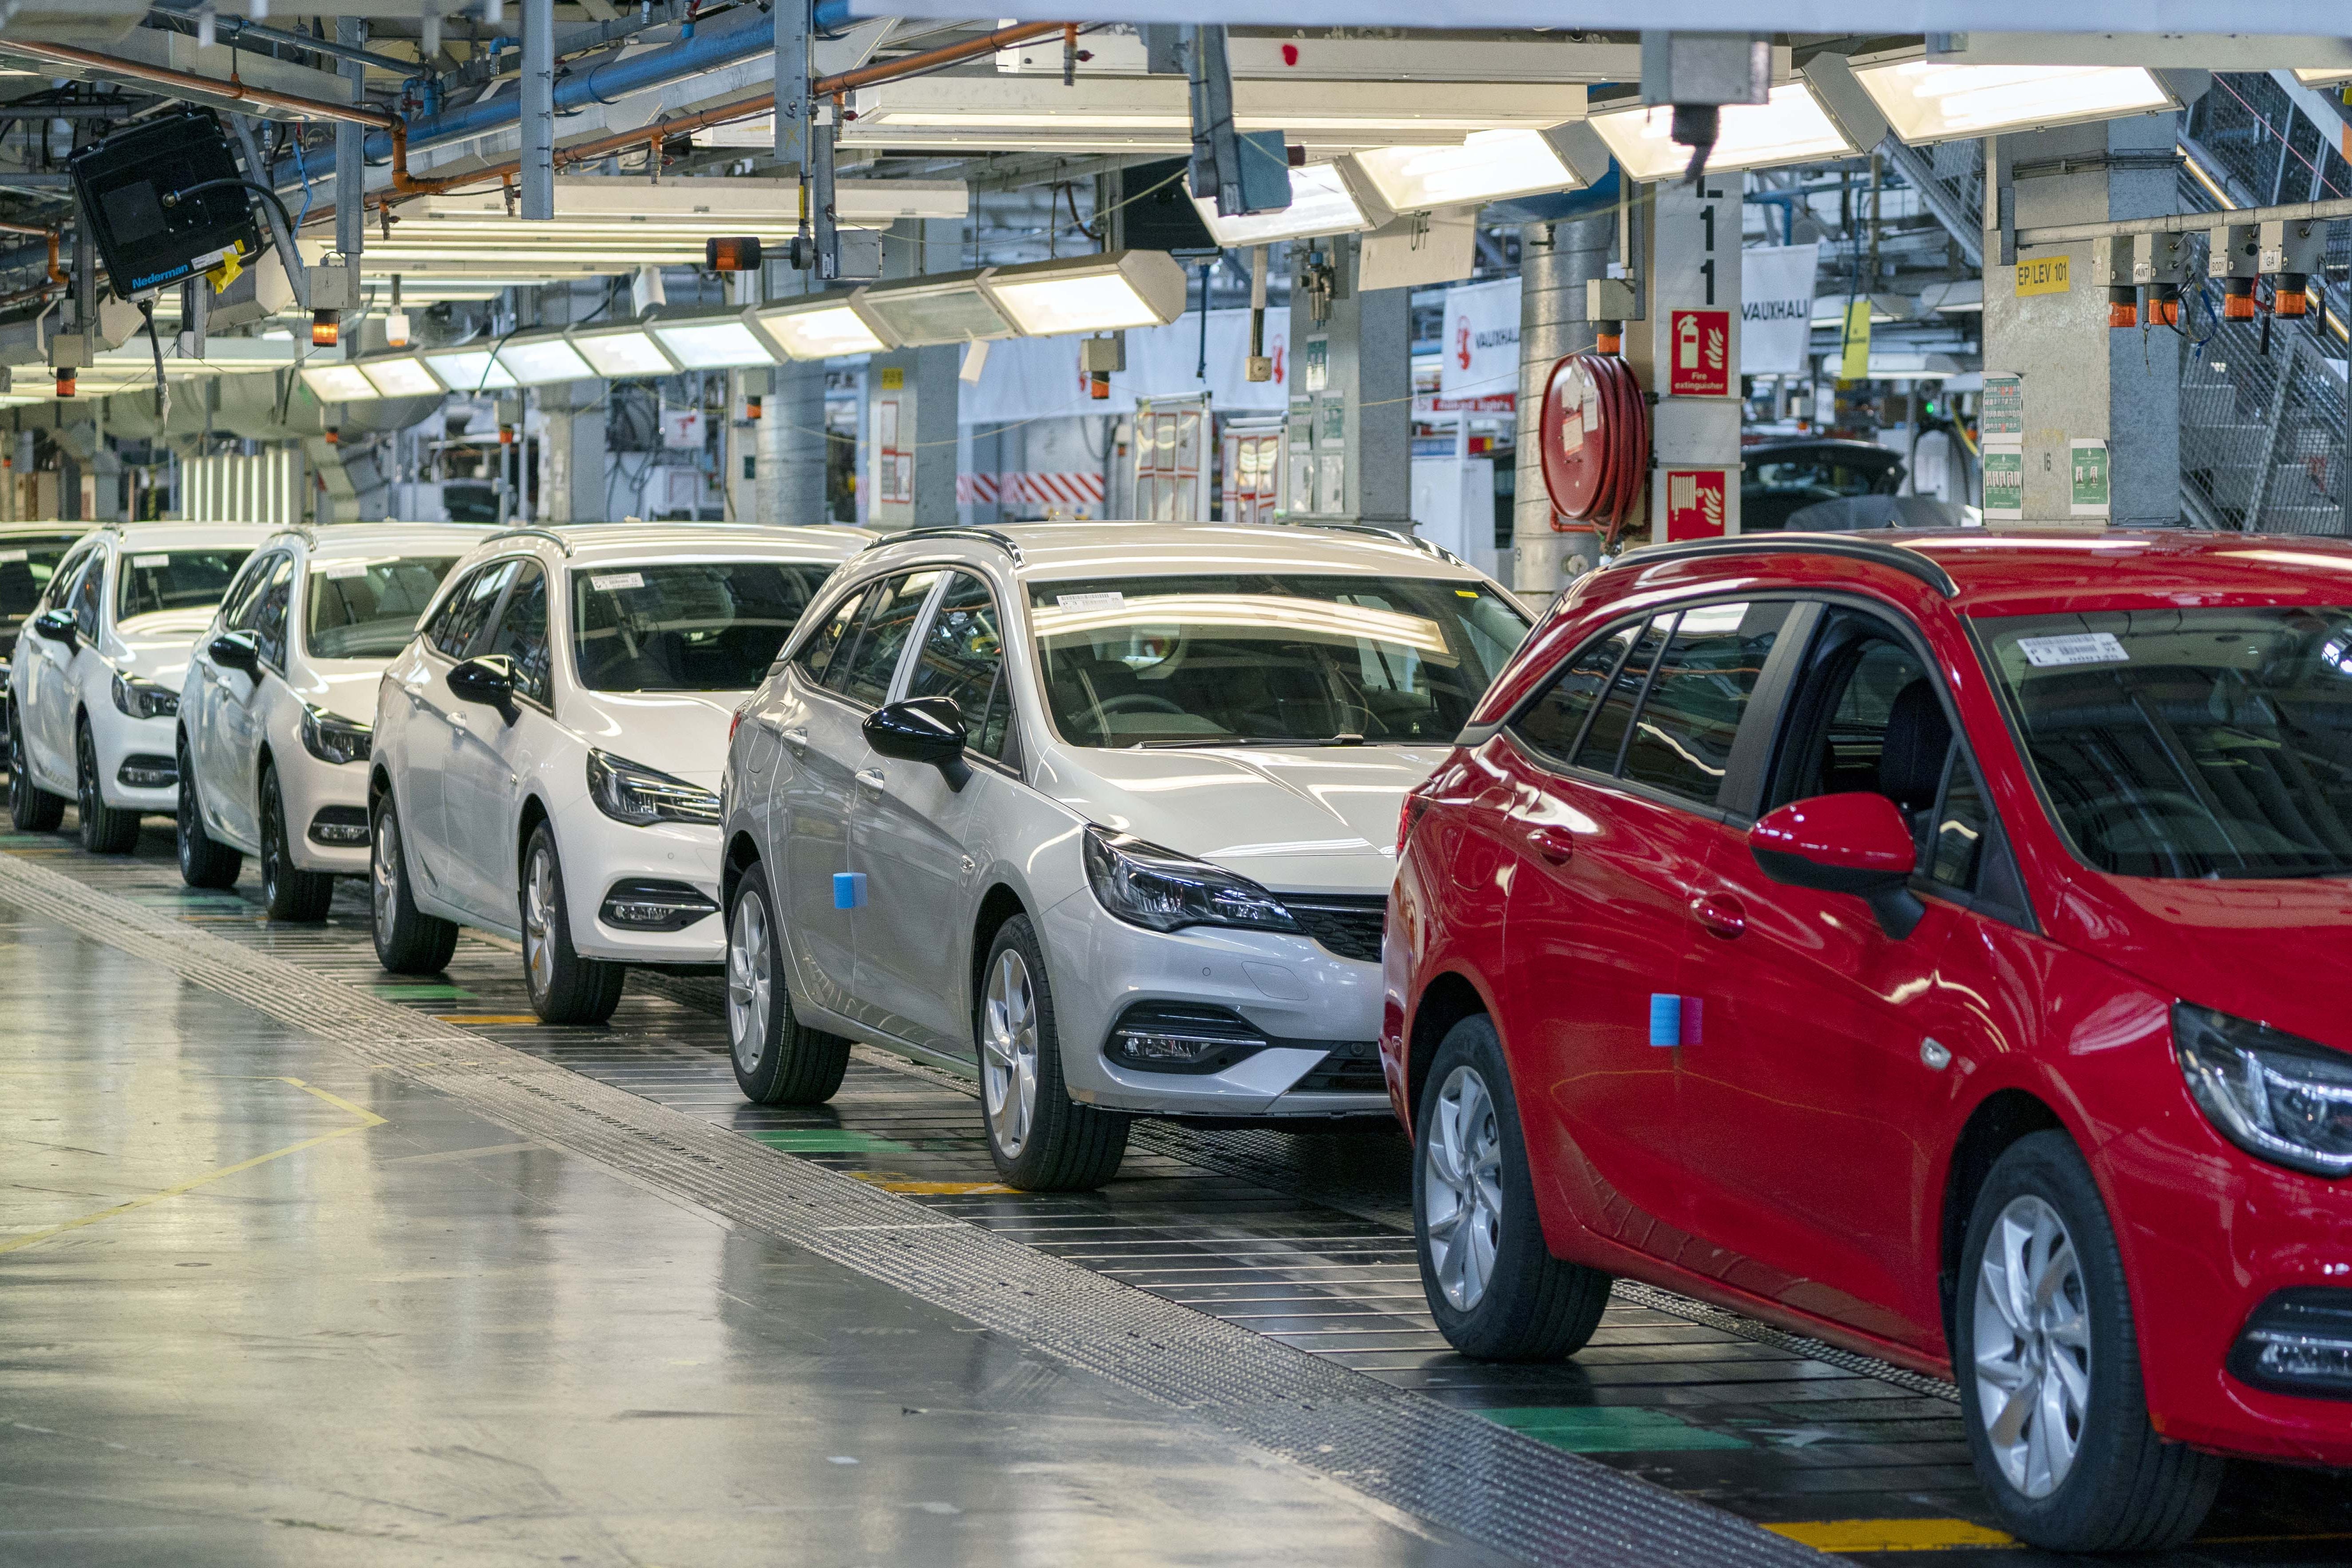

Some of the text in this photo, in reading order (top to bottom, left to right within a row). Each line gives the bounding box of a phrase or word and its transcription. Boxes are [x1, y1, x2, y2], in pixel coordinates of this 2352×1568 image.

[2266, 256, 2275, 266] GA
[2212, 261, 2225, 272] BODY
[132, 264, 188, 289] Nederman
[2019, 262, 2067, 286] EP/LEV 101
[2135, 268, 2148, 277] PAINT
[1692, 372, 1707, 380] Fire
[1675, 381, 1724, 391] extinguisher
[2043, 452, 2051, 471] 16
